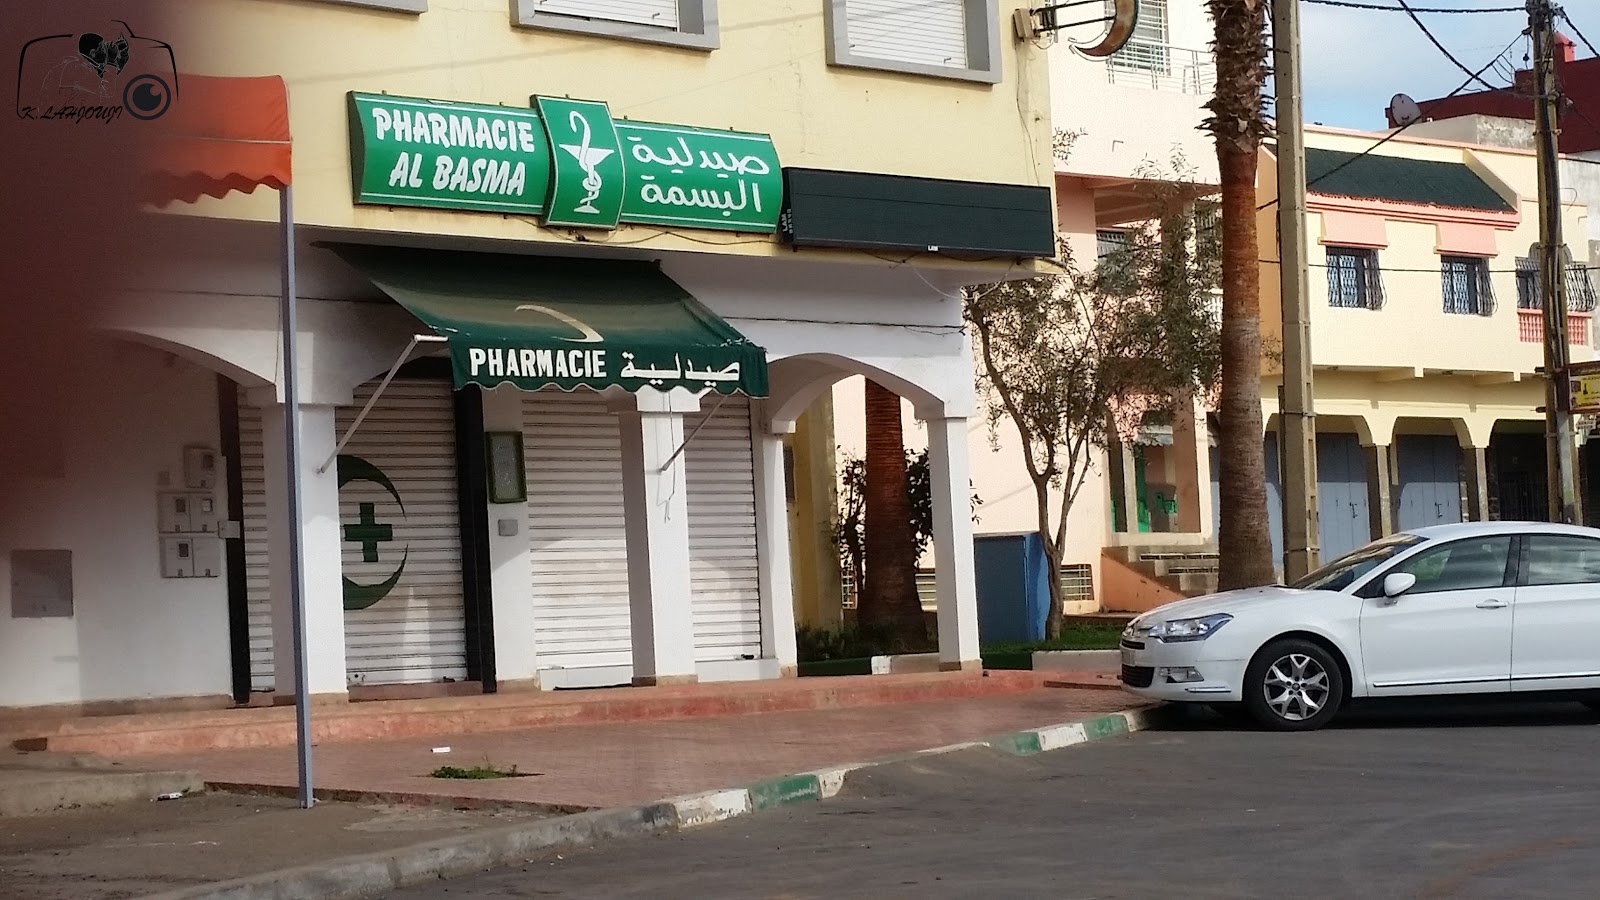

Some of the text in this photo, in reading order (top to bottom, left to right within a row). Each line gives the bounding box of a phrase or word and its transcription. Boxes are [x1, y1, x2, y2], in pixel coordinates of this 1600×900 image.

[372, 107, 535, 152] PHARMACIE
[388, 151, 526, 196] AL BASMA
[627, 136, 770, 178] صيدلية
[640, 174, 762, 216] البسمة
[469, 348, 607, 378] PHARMACIE
[620, 351, 740, 387] صيدلية
